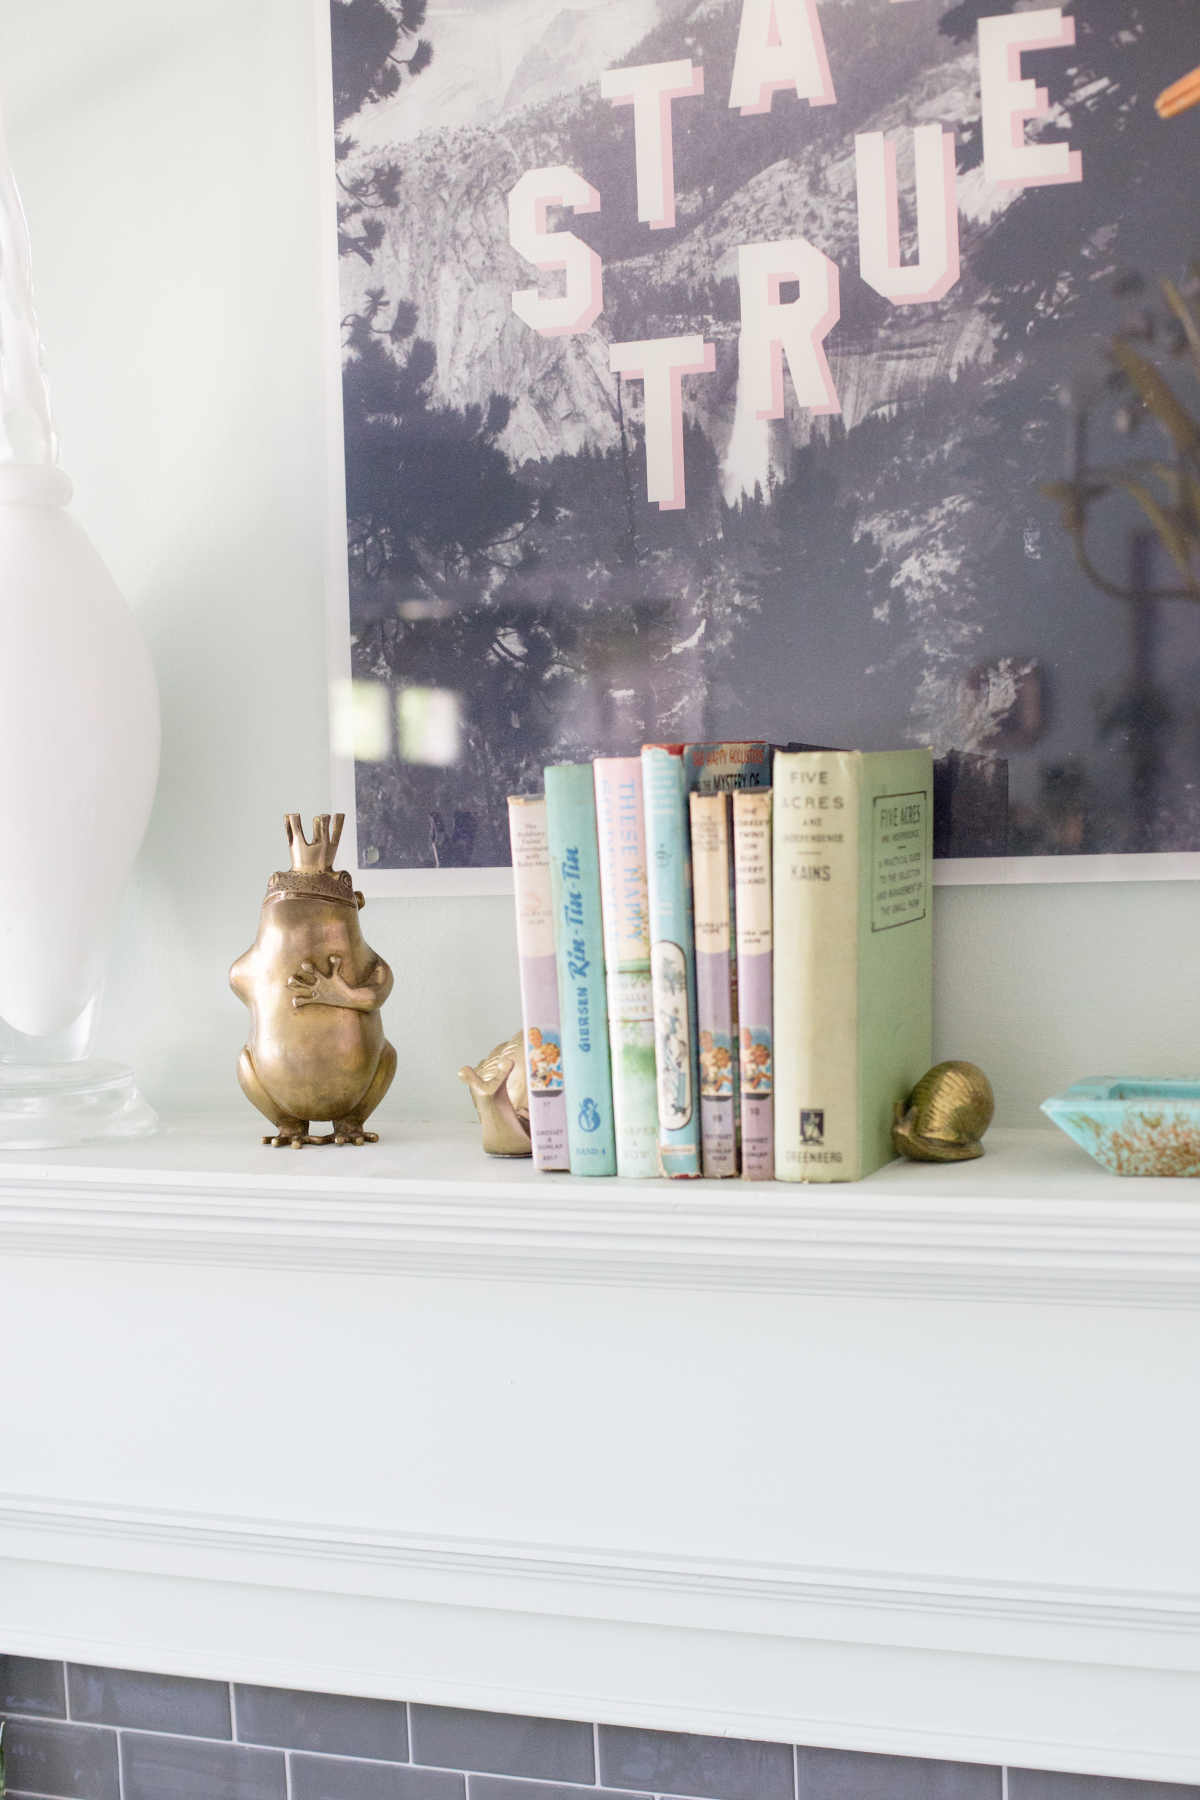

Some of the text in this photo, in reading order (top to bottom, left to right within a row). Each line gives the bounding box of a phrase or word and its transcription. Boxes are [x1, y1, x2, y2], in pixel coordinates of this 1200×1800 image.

[713, 773, 748, 791] MYSTERY
[790, 771, 829, 784] FIVE
[782, 796, 844, 810] ACRES
[880, 803, 921, 828] FIVE ACRES
[619, 780, 644, 943] THESE HAPPY
[791, 865, 831, 881] KAINS
[562, 846, 590, 980] Rin-Tin-Tin
